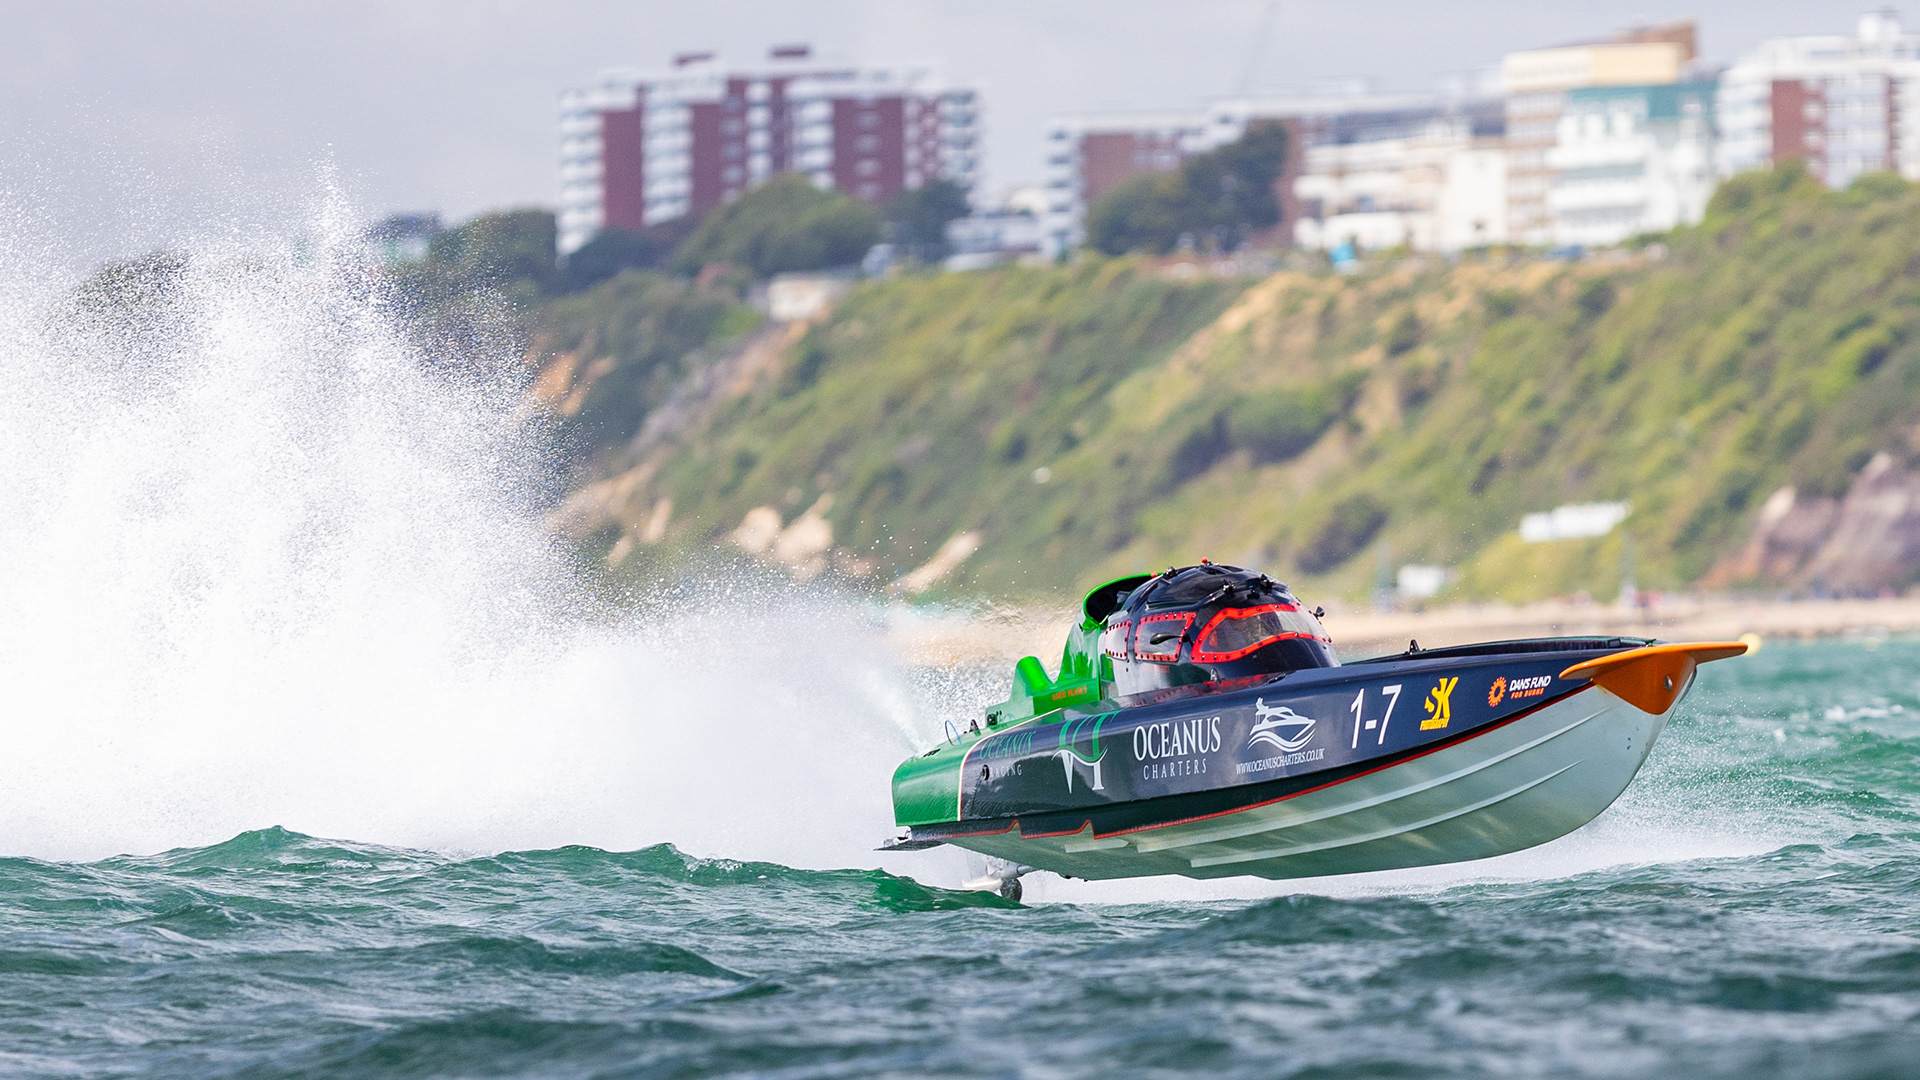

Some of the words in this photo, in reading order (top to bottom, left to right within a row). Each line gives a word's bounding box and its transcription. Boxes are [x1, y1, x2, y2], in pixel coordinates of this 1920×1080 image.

[1511, 691, 1523, 699] FOR
[1530, 675, 1552, 689] FUND
[1350, 684, 1402, 749] 1-7
[980, 730, 1037, 760] OCEANUS
[1133, 716, 1221, 761] OCEANUS
[1143, 758, 1207, 780] CHARTERS
[1235, 748, 1325, 775] WWW.OCEANUSCHARTERS.CO.UK
